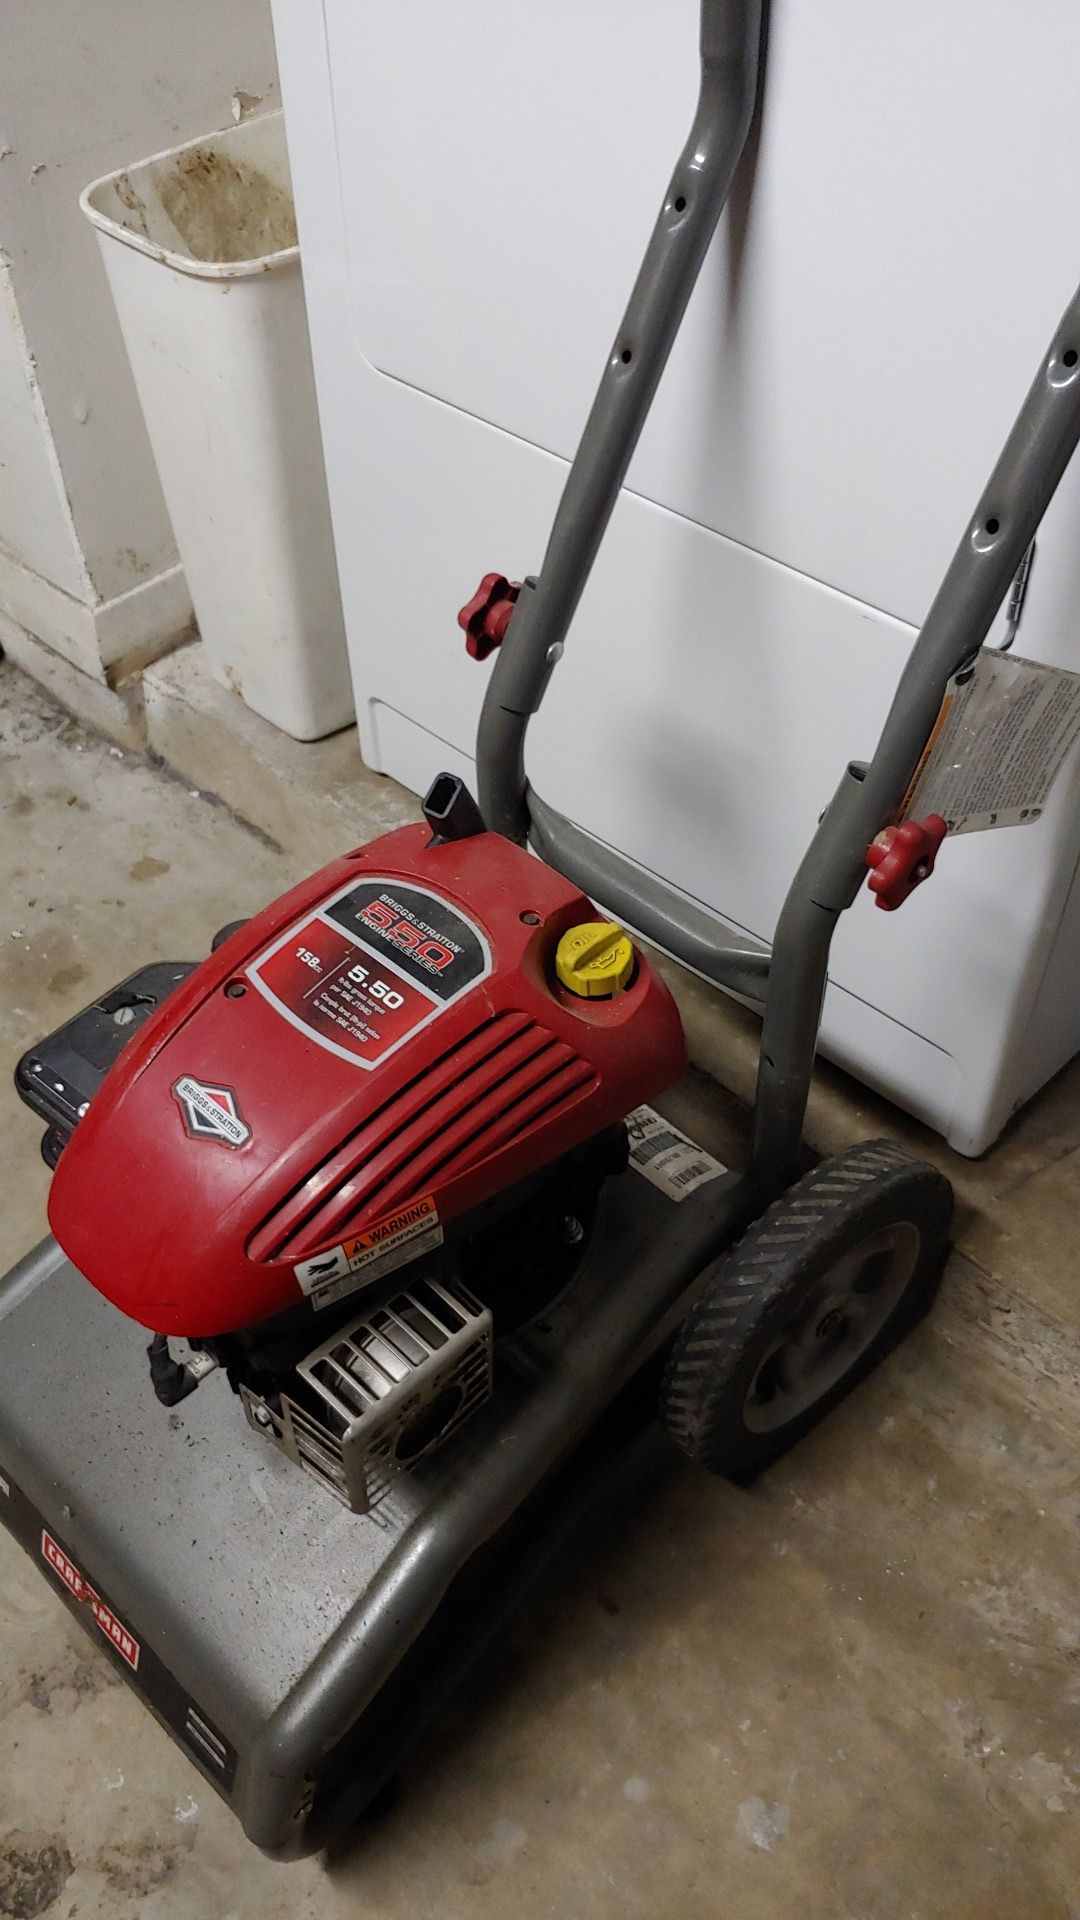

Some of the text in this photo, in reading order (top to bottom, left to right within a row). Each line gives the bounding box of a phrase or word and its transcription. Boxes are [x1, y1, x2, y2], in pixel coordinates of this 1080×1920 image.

[360, 899, 455, 970] 550
[340, 990, 354, 1002] SAE
[351, 1000, 373, 1016] J1940
[347, 964, 404, 1010] 5.50
[335, 1016, 350, 1029] SAE
[353, 1216, 434, 1267] HOT SURFACES
[368, 1202, 430, 1244] WARNING
[48, 1543, 132, 1657] CRAFMAN
